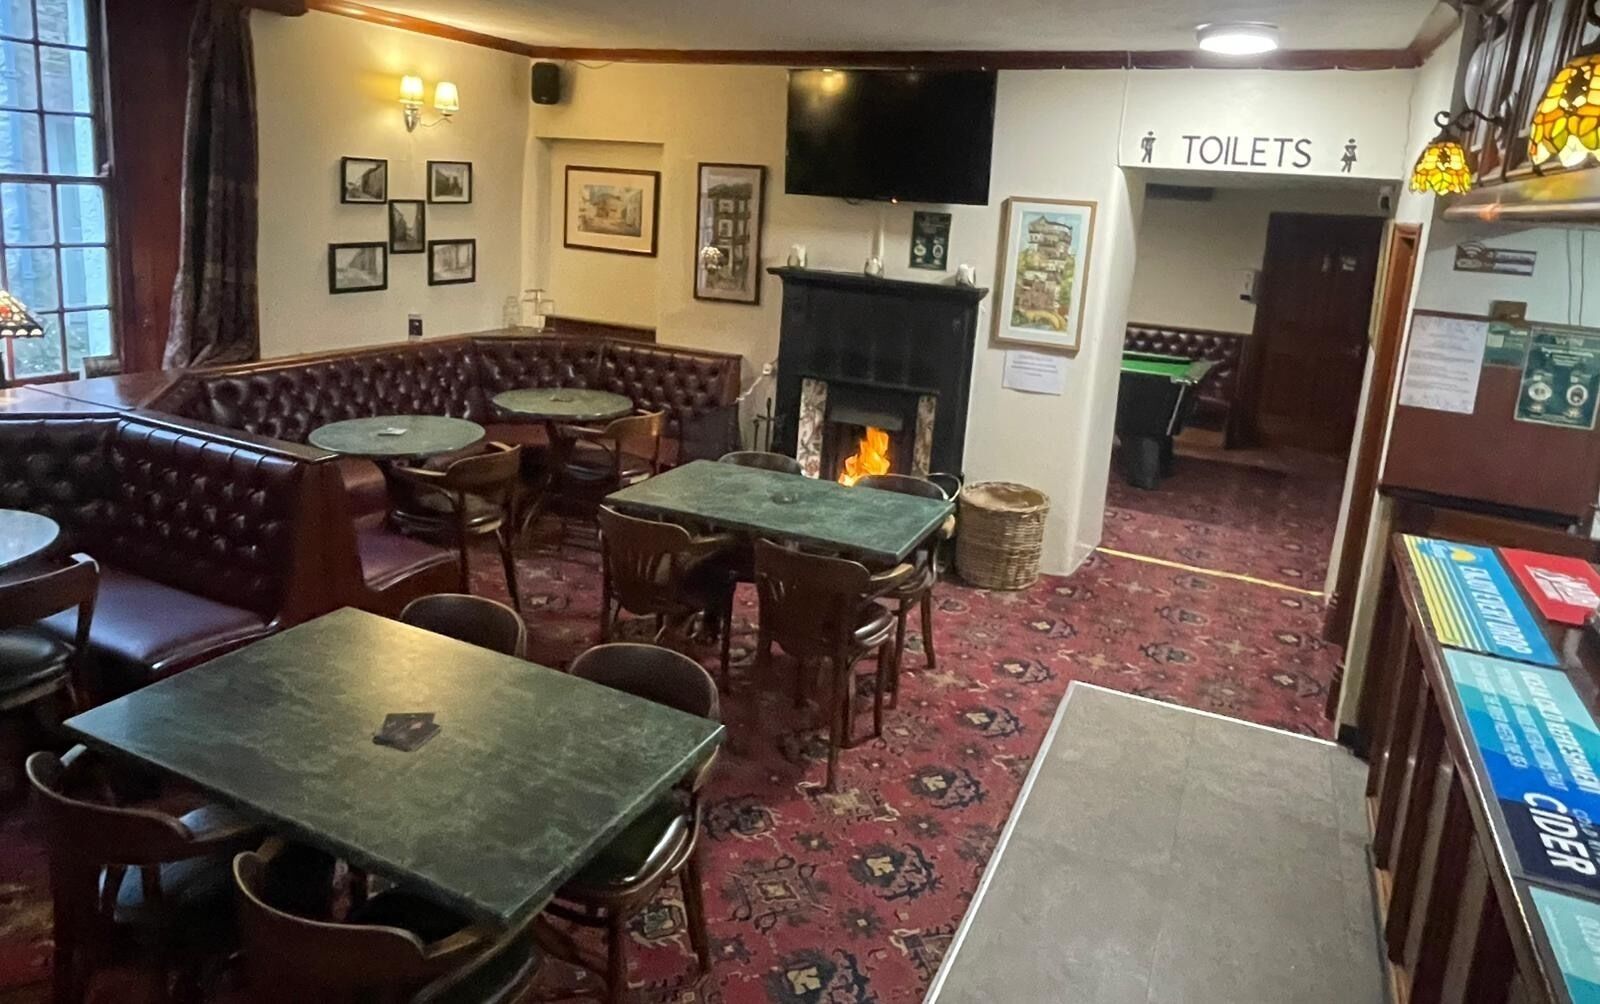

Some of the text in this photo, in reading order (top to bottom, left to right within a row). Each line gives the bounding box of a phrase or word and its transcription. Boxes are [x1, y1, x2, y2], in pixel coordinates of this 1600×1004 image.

[1181, 135, 1313, 169] TOILETS
[1458, 565, 1500, 596] ENJOY
[1471, 591, 1518, 627] EVERY
[1486, 621, 1533, 655] DROP
[1523, 792, 1597, 875] CIDER
